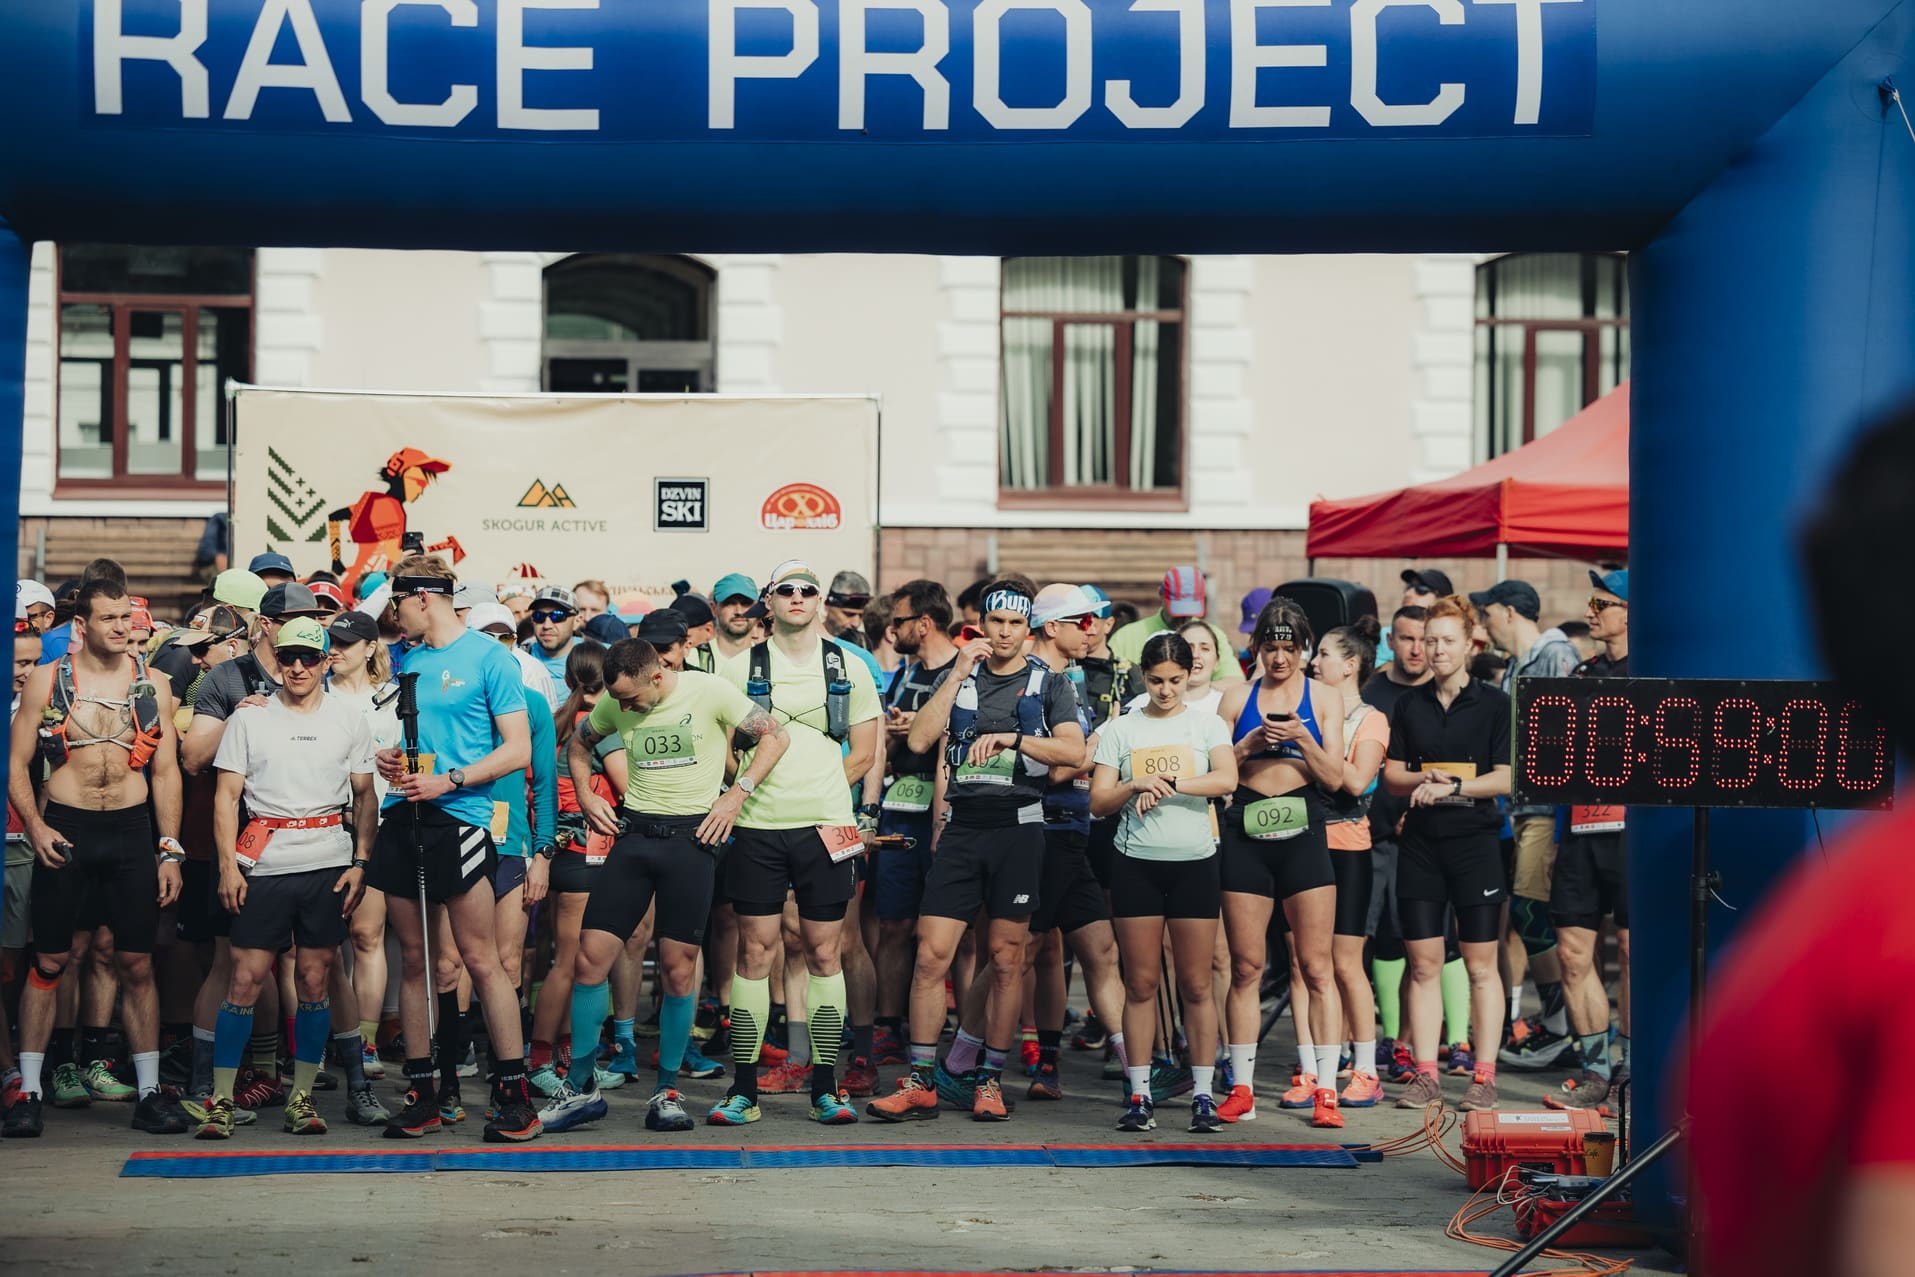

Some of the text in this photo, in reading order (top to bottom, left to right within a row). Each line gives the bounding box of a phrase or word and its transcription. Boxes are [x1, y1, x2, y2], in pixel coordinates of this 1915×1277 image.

[94, 0, 1583, 130] RACE PROJECT
[661, 500, 702, 522] SKI
[482, 519, 607, 532] SKOGUR ACTIVE
[644, 734, 682, 755] 033
[1145, 755, 1181, 775] 808
[896, 783, 925, 798] 069
[1257, 806, 1294, 827] 092
